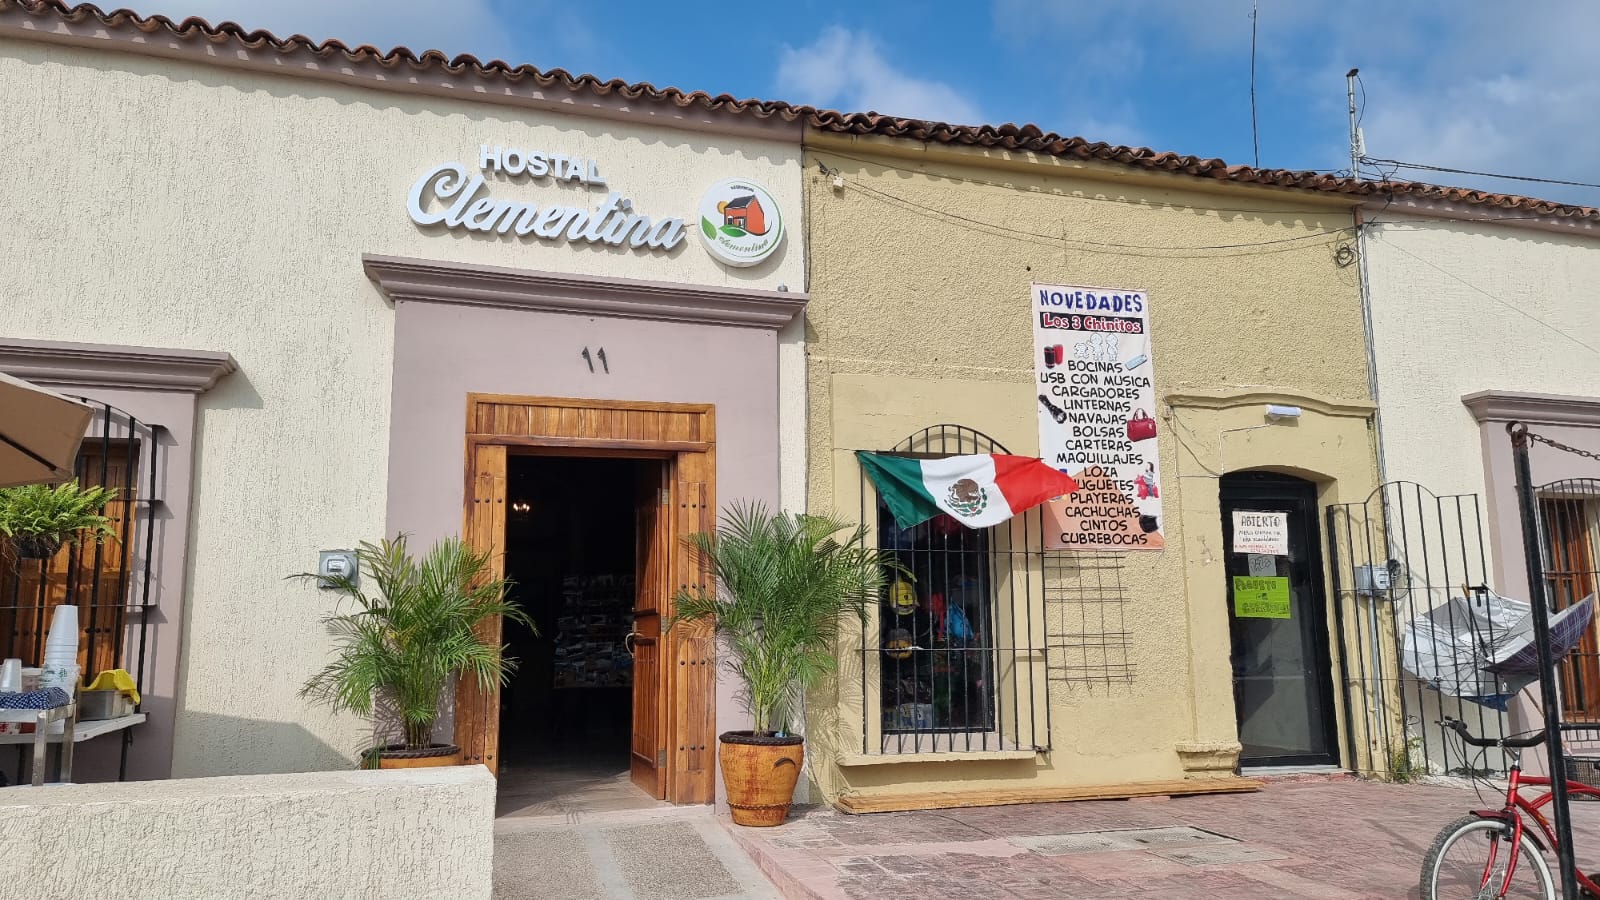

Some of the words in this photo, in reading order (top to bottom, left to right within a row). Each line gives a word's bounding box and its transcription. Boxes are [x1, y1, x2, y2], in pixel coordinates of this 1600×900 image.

[479, 144, 607, 186] HOSTAL
[406, 161, 689, 251] Clementina
[1039, 289, 1143, 313] NOVEDADES
[1043, 312, 1069, 327] Los
[1072, 315, 1081, 330] 3
[1083, 315, 1142, 333] Chinitos
[581, 345, 610, 375] 11
[1067, 359, 1123, 373] BOCINAS
[1040, 372, 1066, 384] USB
[1070, 373, 1098, 385] CON
[1103, 375, 1151, 388] MUSICA
[1051, 385, 1140, 400] CARGADORES
[1063, 399, 1131, 412] LINTERNAS
[1068, 412, 1128, 425] NAVAJAS
[1072, 425, 1125, 438] BOLSAS
[1065, 439, 1133, 452] CARTERAS
[1056, 452, 1144, 465] MAQUILLAJES
[1084, 465, 1118, 478] LOZA
[1074, 479, 1135, 492] UGUETES
[1070, 492, 1134, 505] PLAYERAS
[1065, 506, 1141, 519] CACHUCHAS
[1080, 519, 1128, 532] CINTOS
[1241, 515, 1281, 528] ABIERTO
[1060, 532, 1148, 546] CUBREBOCAS
